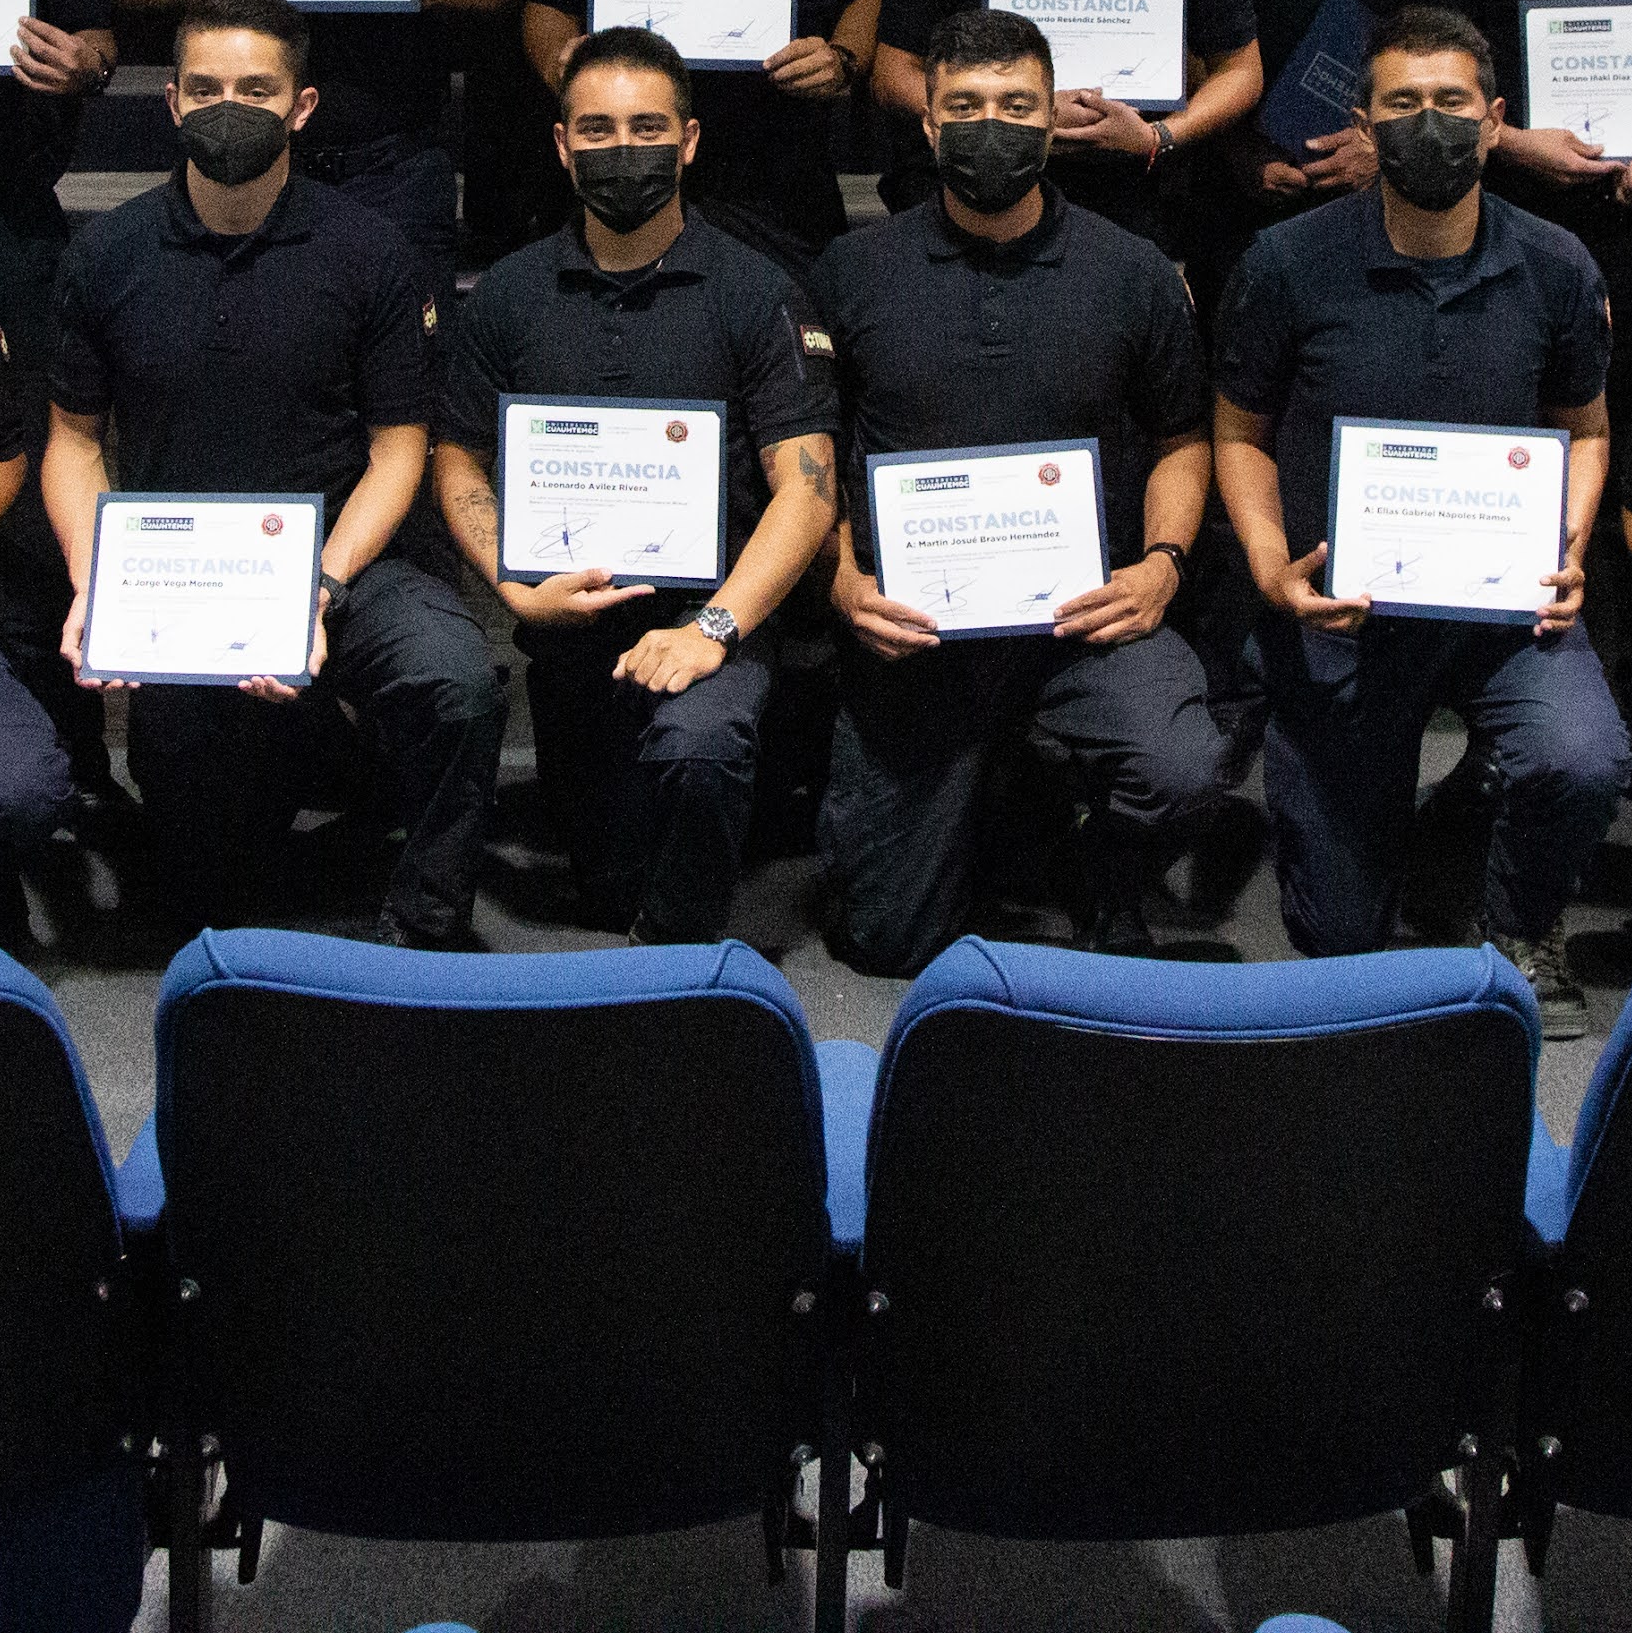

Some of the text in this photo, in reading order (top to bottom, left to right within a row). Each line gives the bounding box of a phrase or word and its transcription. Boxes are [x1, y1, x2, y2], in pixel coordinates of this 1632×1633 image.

[1563, 74, 1589, 83] Bruno
[546, 425, 599, 435] CUAUHTEMOC
[529, 459, 682, 480] CONSTANCIA
[530, 480, 541, 488] A:
[542, 481, 586, 490] Leonardo
[619, 484, 648, 492] Rivera
[1364, 484, 1522, 508] CONSTANCIA
[904, 508, 1059, 535] CONSTANCIA
[1364, 506, 1375, 514] A:
[1402, 509, 1436, 517] Gabriel
[1479, 514, 1511, 522] Ramos
[906, 541, 917, 549] A:
[951, 536, 977, 545] Josué
[980, 534, 1008, 543] Bravo
[1010, 530, 1060, 540] Hernández
[122, 557, 275, 575] CONSTANCIA
[122, 579, 224, 588] A: Jorge Vega Moreno
